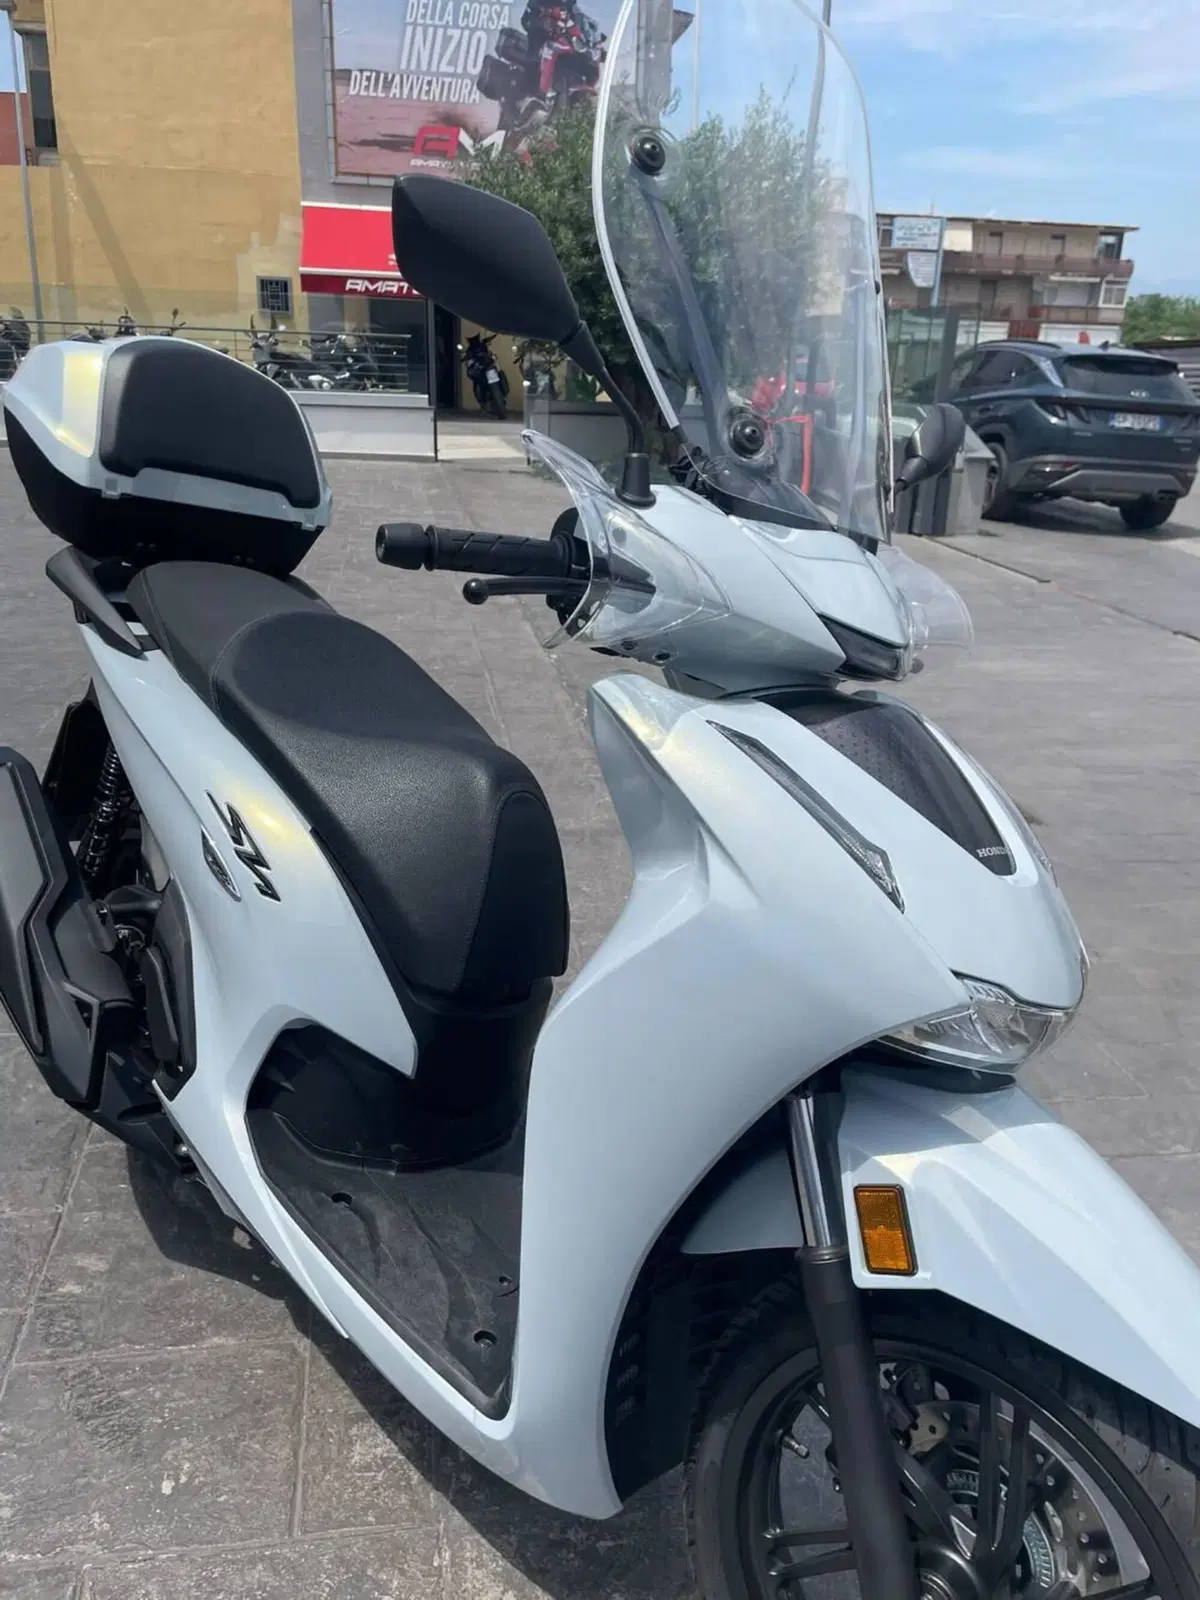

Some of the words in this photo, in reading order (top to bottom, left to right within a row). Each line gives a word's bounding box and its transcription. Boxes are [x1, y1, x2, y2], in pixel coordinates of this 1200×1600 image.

[405, 0, 453, 26] DELLA
[458, 2, 510, 30] CORSA
[400, 25, 488, 76] INIZIO
[348, 70, 480, 104] DELL'AVVENTURA
[345, 278, 421, 295] AMAT
